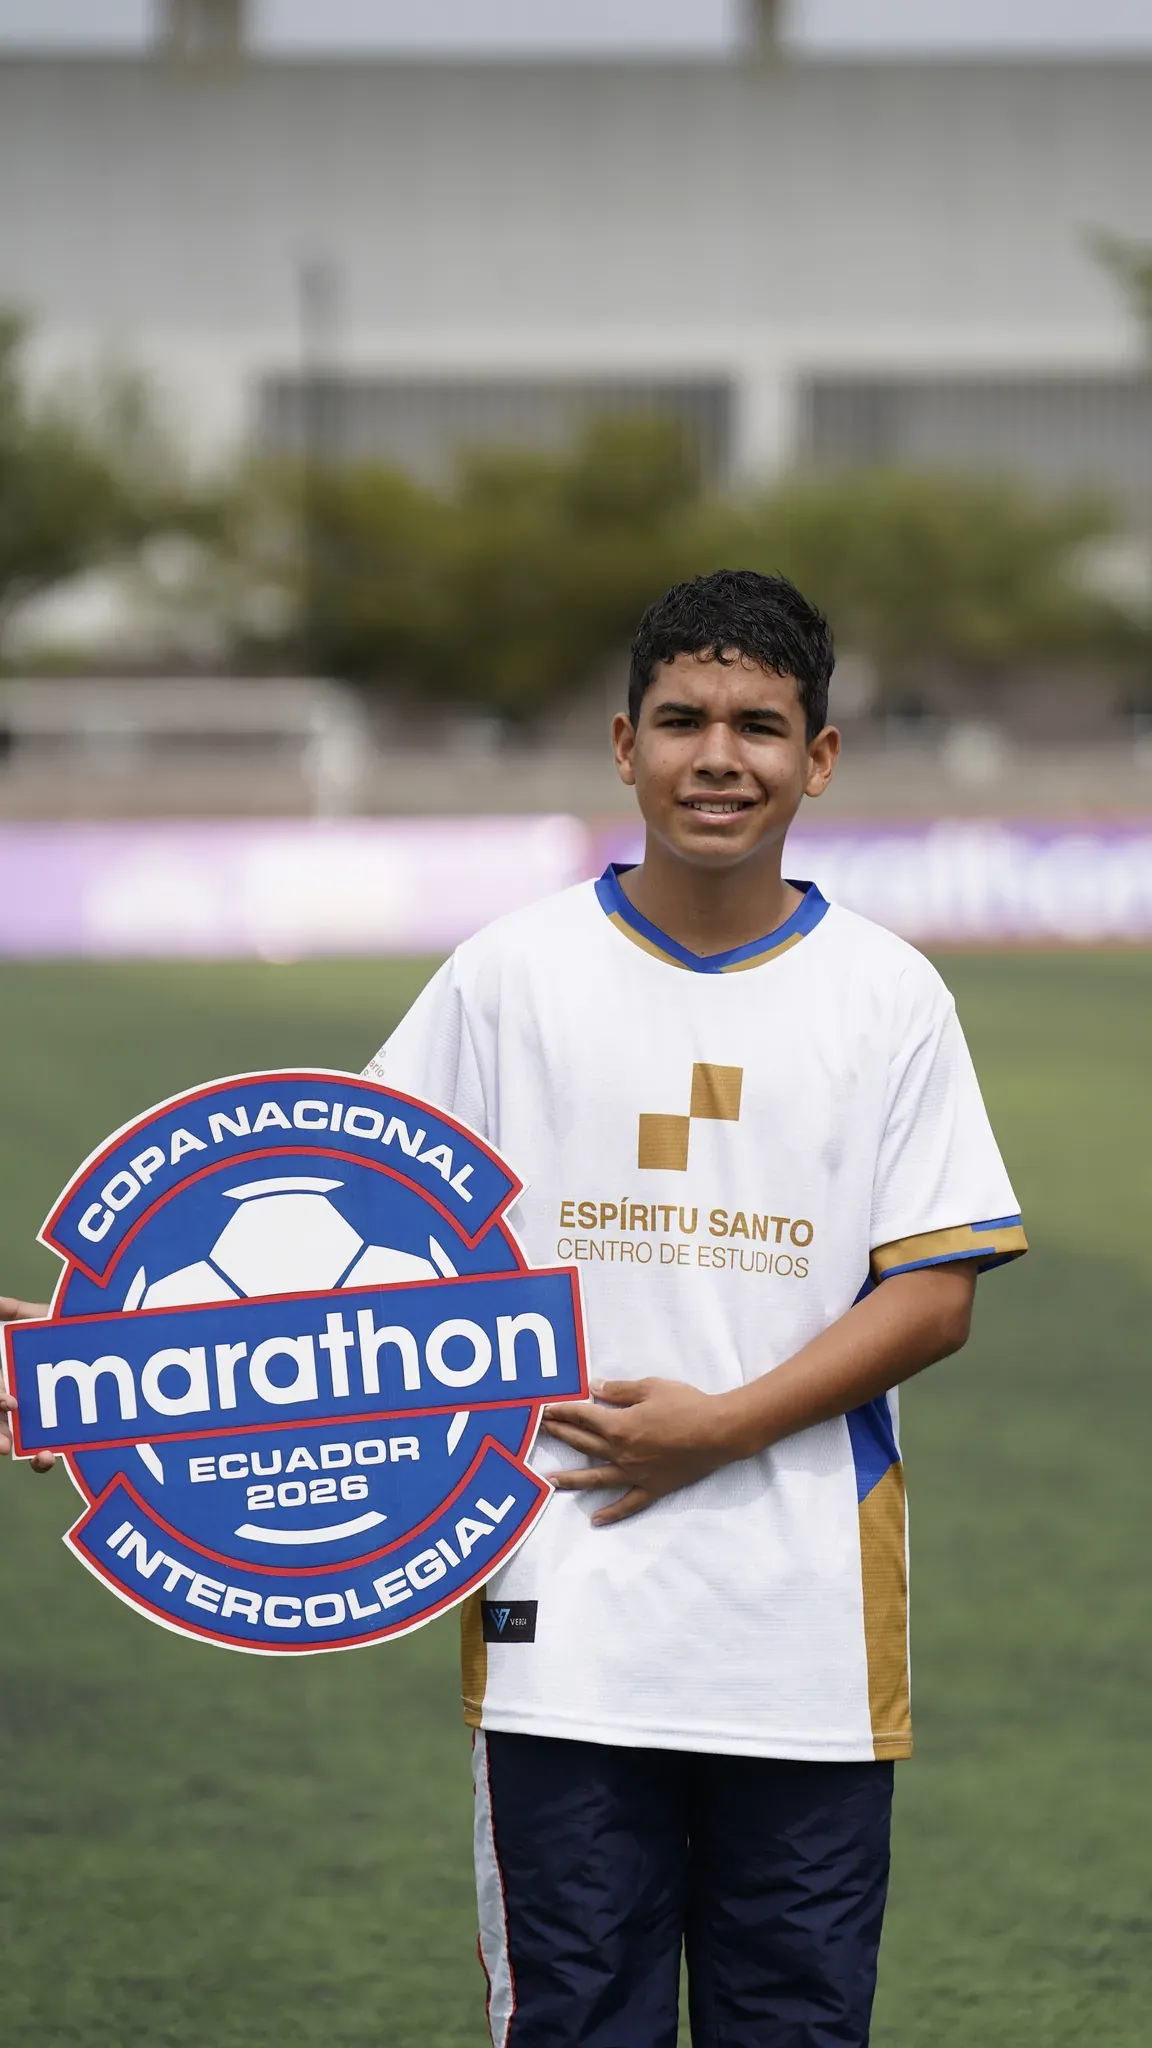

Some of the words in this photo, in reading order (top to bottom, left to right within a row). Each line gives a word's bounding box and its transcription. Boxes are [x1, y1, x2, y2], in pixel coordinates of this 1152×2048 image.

[78, 1130, 208, 1243] COPA
[208, 1100, 475, 1203] NACIONAL
[559, 1197, 698, 1234] ESPÍRITU
[708, 1209, 814, 1247] SANTO
[557, 1238, 653, 1264] CENTRO
[660, 1243, 691, 1265] DE
[697, 1246, 810, 1278] ESTUDIOS
[37, 1309, 558, 1428] marathon
[189, 1437, 420, 1483] ECUADOR
[246, 1475, 369, 1511] 2026
[106, 1492, 516, 1628] INTERCOLEGIAL
